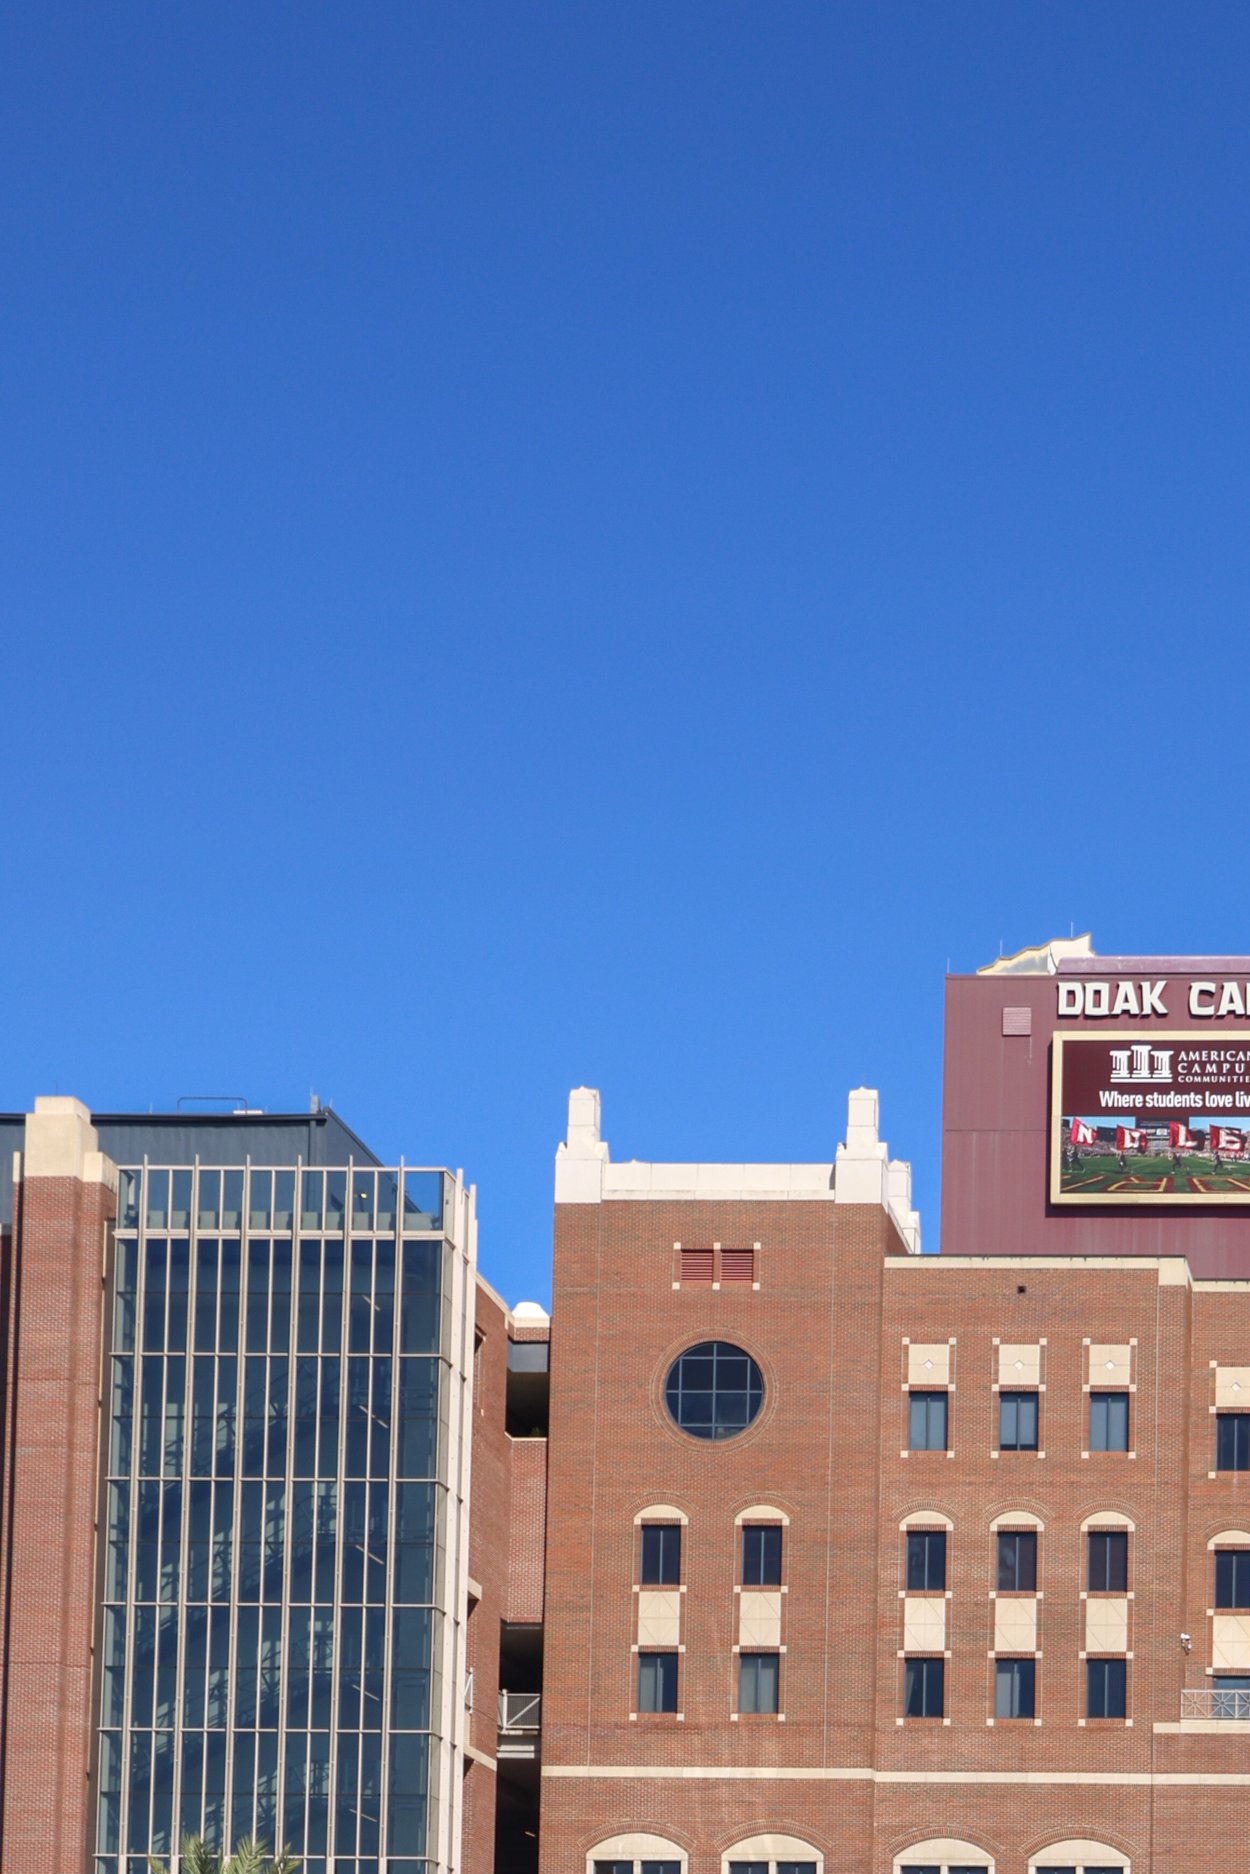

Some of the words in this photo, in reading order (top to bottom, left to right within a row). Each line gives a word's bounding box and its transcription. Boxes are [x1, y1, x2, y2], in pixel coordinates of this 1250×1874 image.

[1057, 980, 1168, 1017] DOAK
[1099, 1091, 1143, 1108] Where
[1145, 1091, 1203, 1108] students
[1205, 1091, 1233, 1108] love
